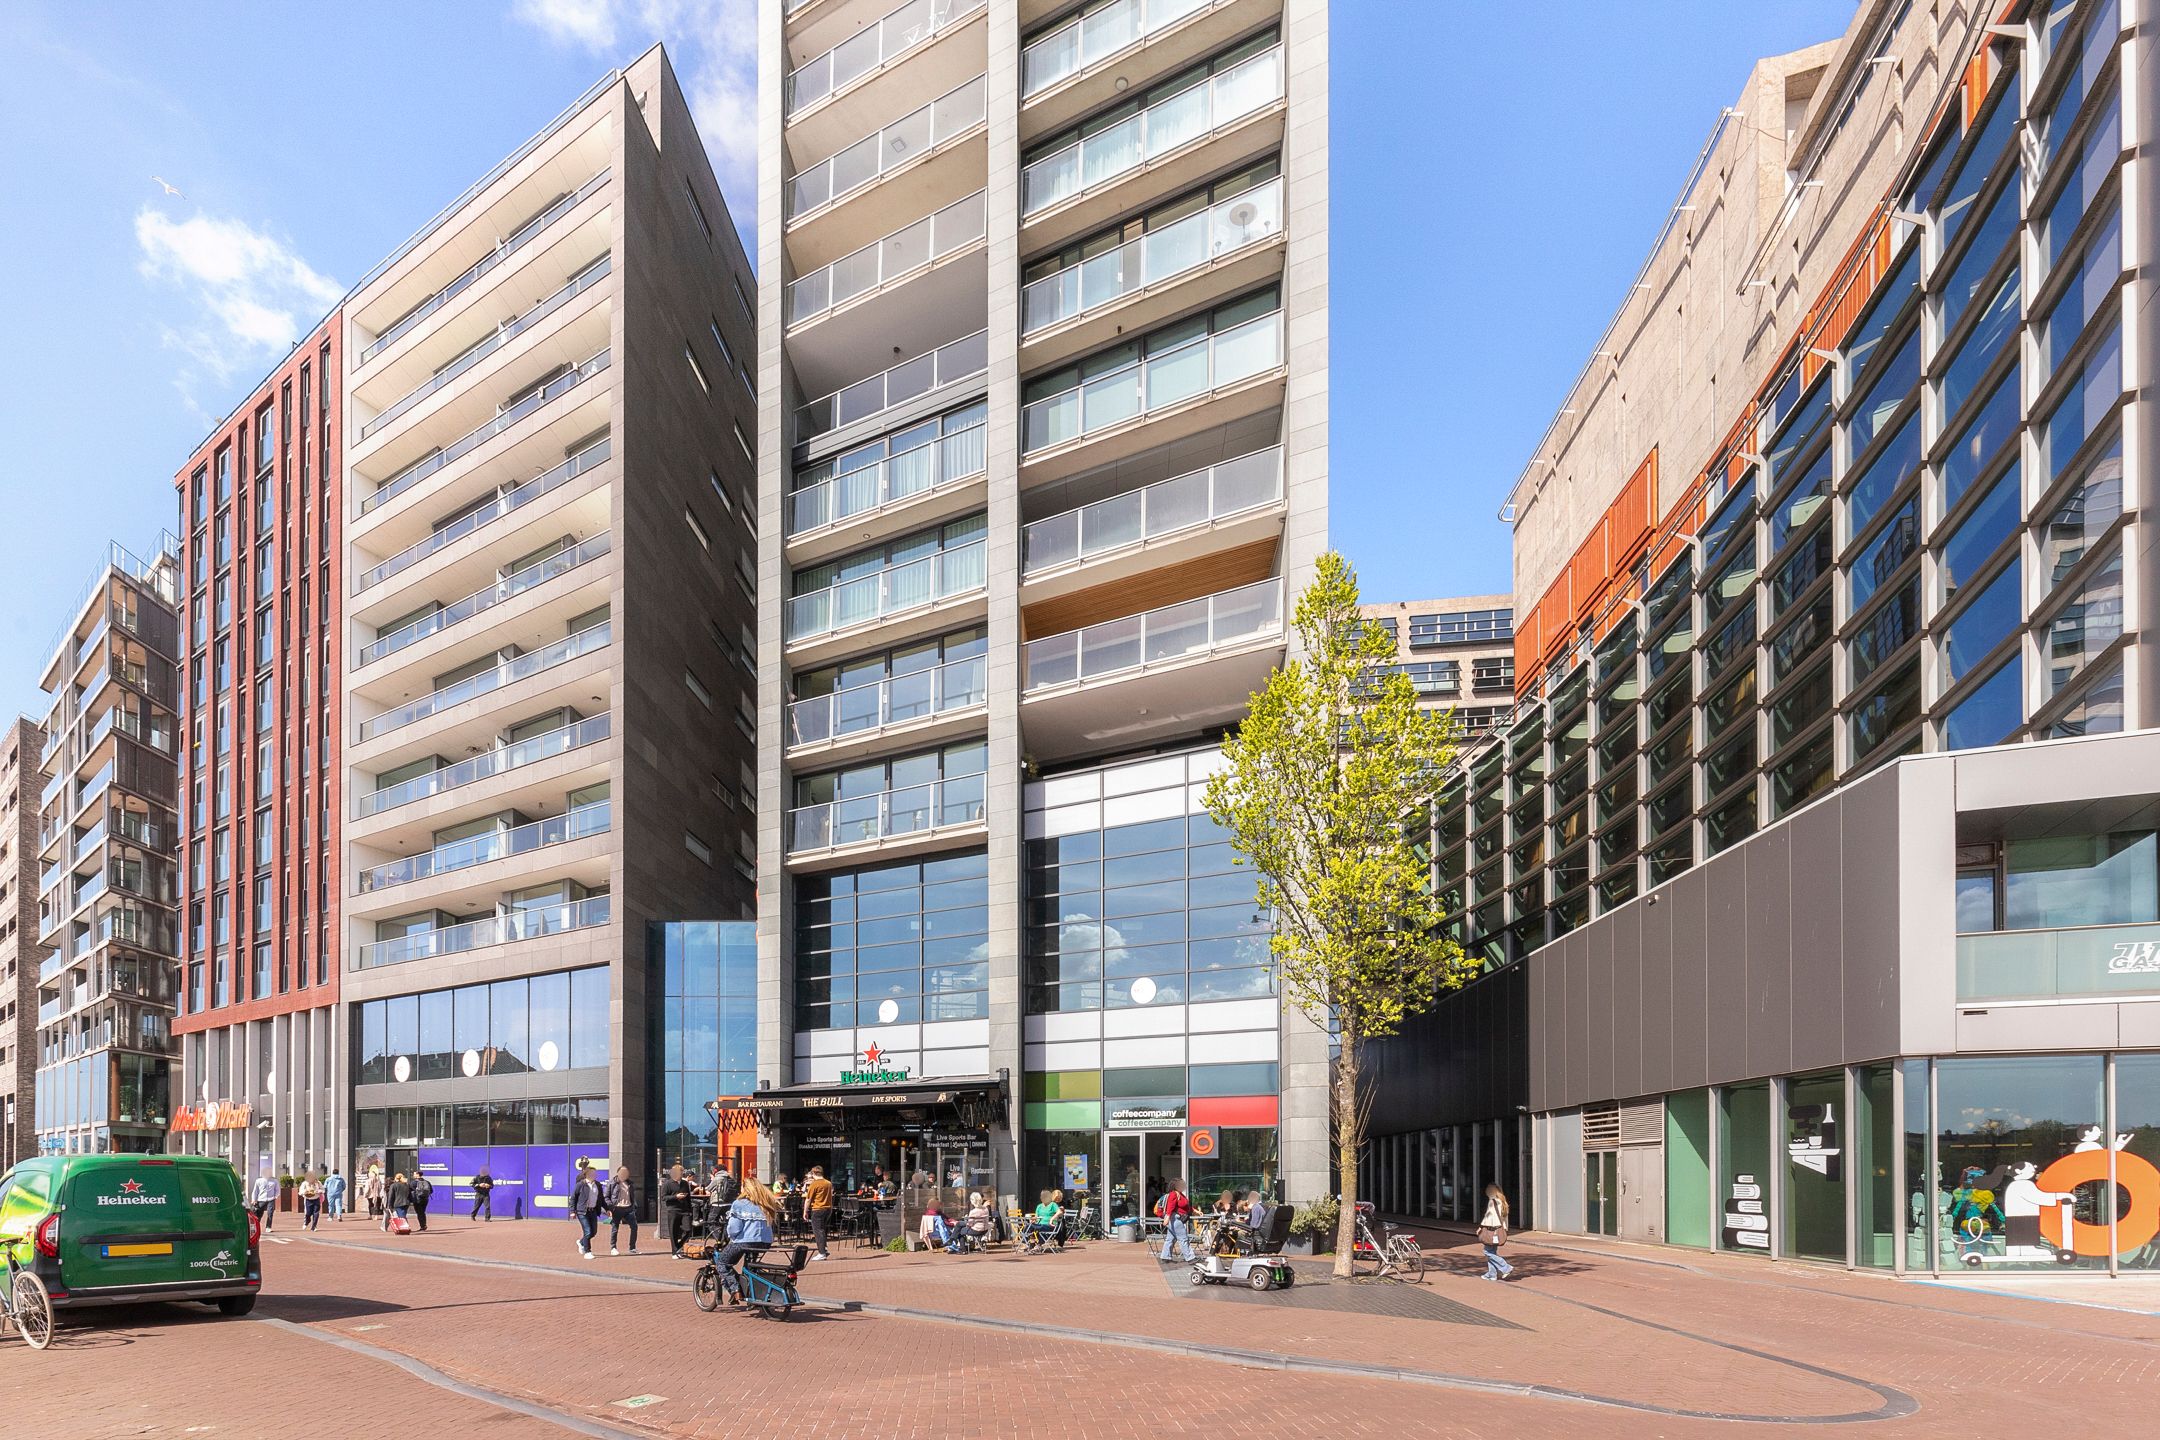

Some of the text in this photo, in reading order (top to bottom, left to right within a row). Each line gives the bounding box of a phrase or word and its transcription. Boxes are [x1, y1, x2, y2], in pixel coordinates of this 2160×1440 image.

[840, 1070, 908, 1085] Heineken
[802, 1096, 844, 1107] THE BULL
[885, 1095, 907, 1103] SPORTS
[1112, 1109, 1177, 1119] coffeecompany
[949, 1134, 966, 1142] Sports
[949, 1164, 961, 1172] Live
[97, 1194, 167, 1206] Heineken
[213, 1259, 239, 1267] Electric
